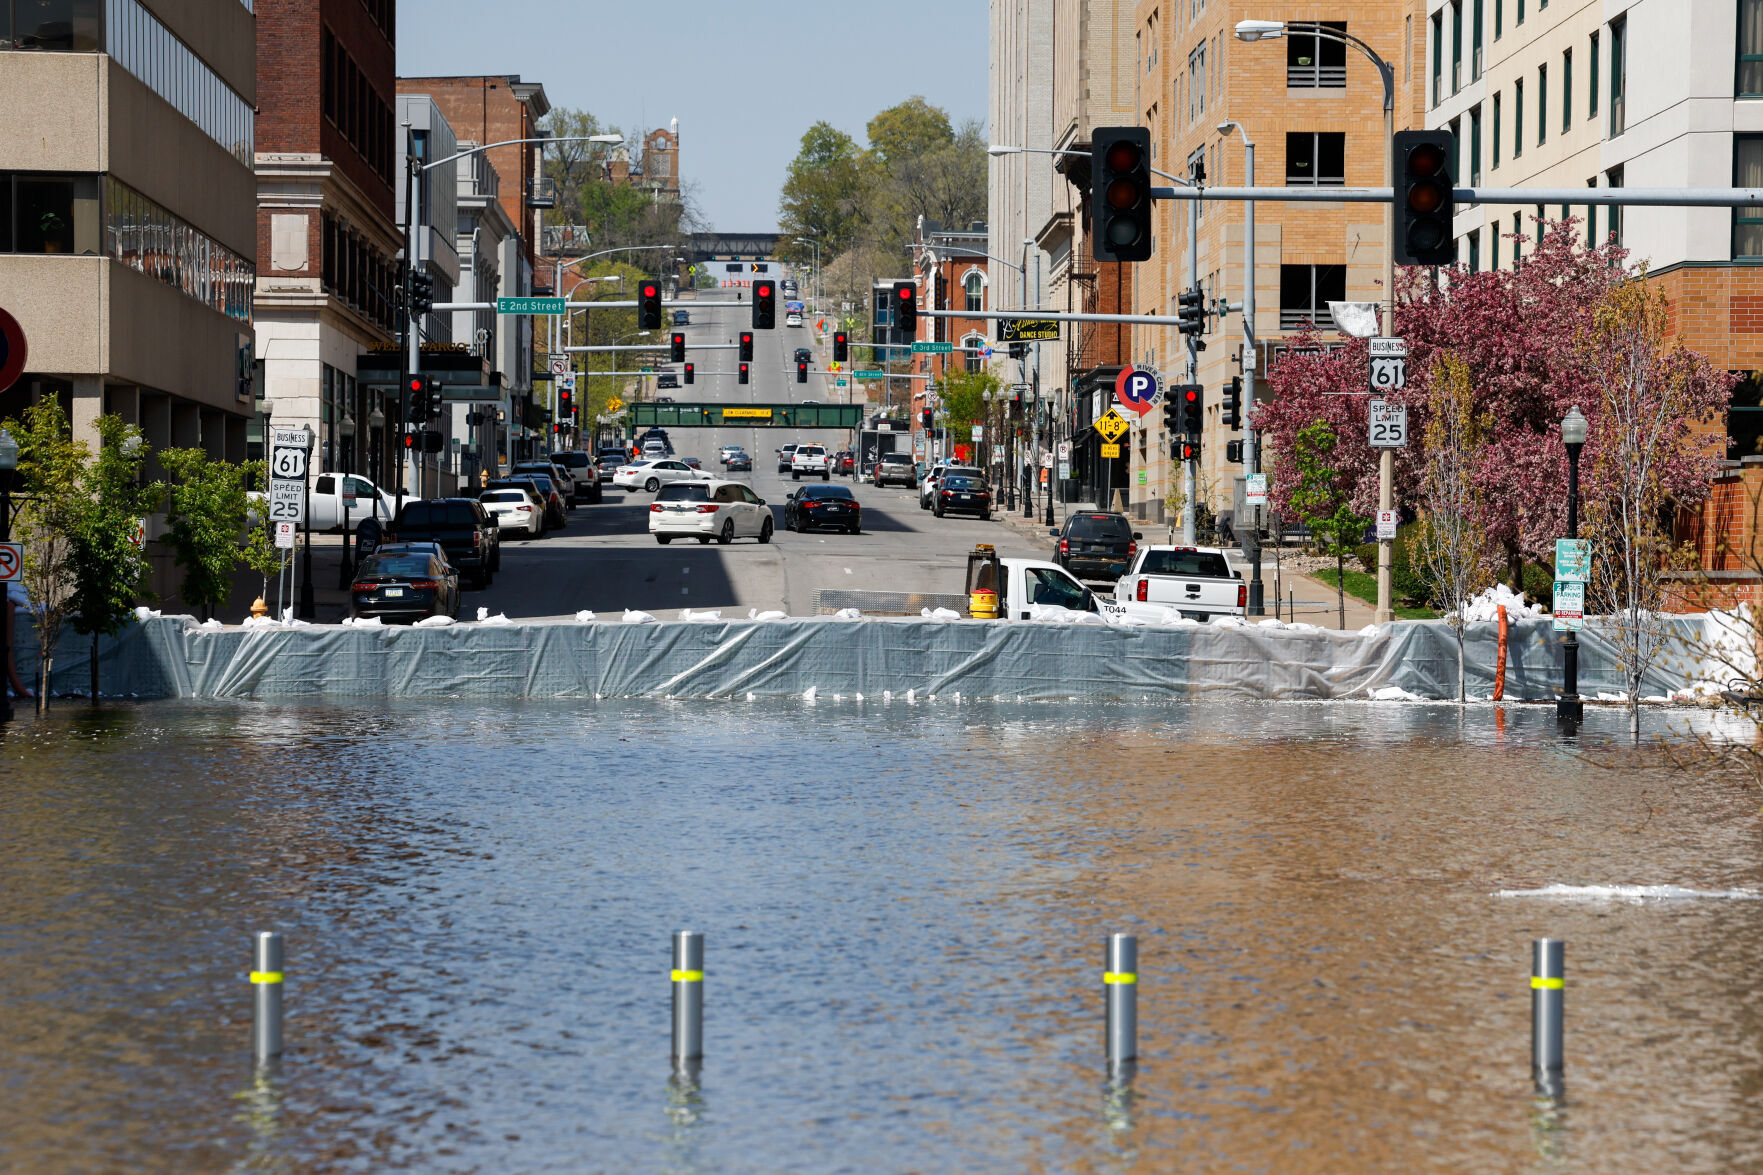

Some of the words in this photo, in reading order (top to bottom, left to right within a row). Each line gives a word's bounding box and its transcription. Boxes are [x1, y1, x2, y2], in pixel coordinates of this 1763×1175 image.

[500, 301, 506, 310] E
[509, 301, 527, 310] 2nd
[530, 301, 562, 311] Street
[1019, 331, 1037, 339] DANCE
[1037, 330, 1058, 339] STUDIO
[420, 342, 467, 351] FARGO
[1376, 365, 1399, 385] 61
[1132, 376, 1149, 397] P
[1137, 364, 1158, 377] RIVER
[1152, 376, 1164, 405] CENTER
[1372, 405, 1404, 413] SPEED
[1375, 414, 1399, 422] LIMIT
[1373, 424, 1402, 441] 25
[276, 433, 306, 443] BUSINESS
[280, 454, 298, 473] 61
[273, 483, 302, 492] SPEED
[275, 492, 299, 500] LIMIT
[272, 501, 299, 518] 25
[1556, 591, 1581, 599] PARKING
[1103, 605, 1126, 614] T044
